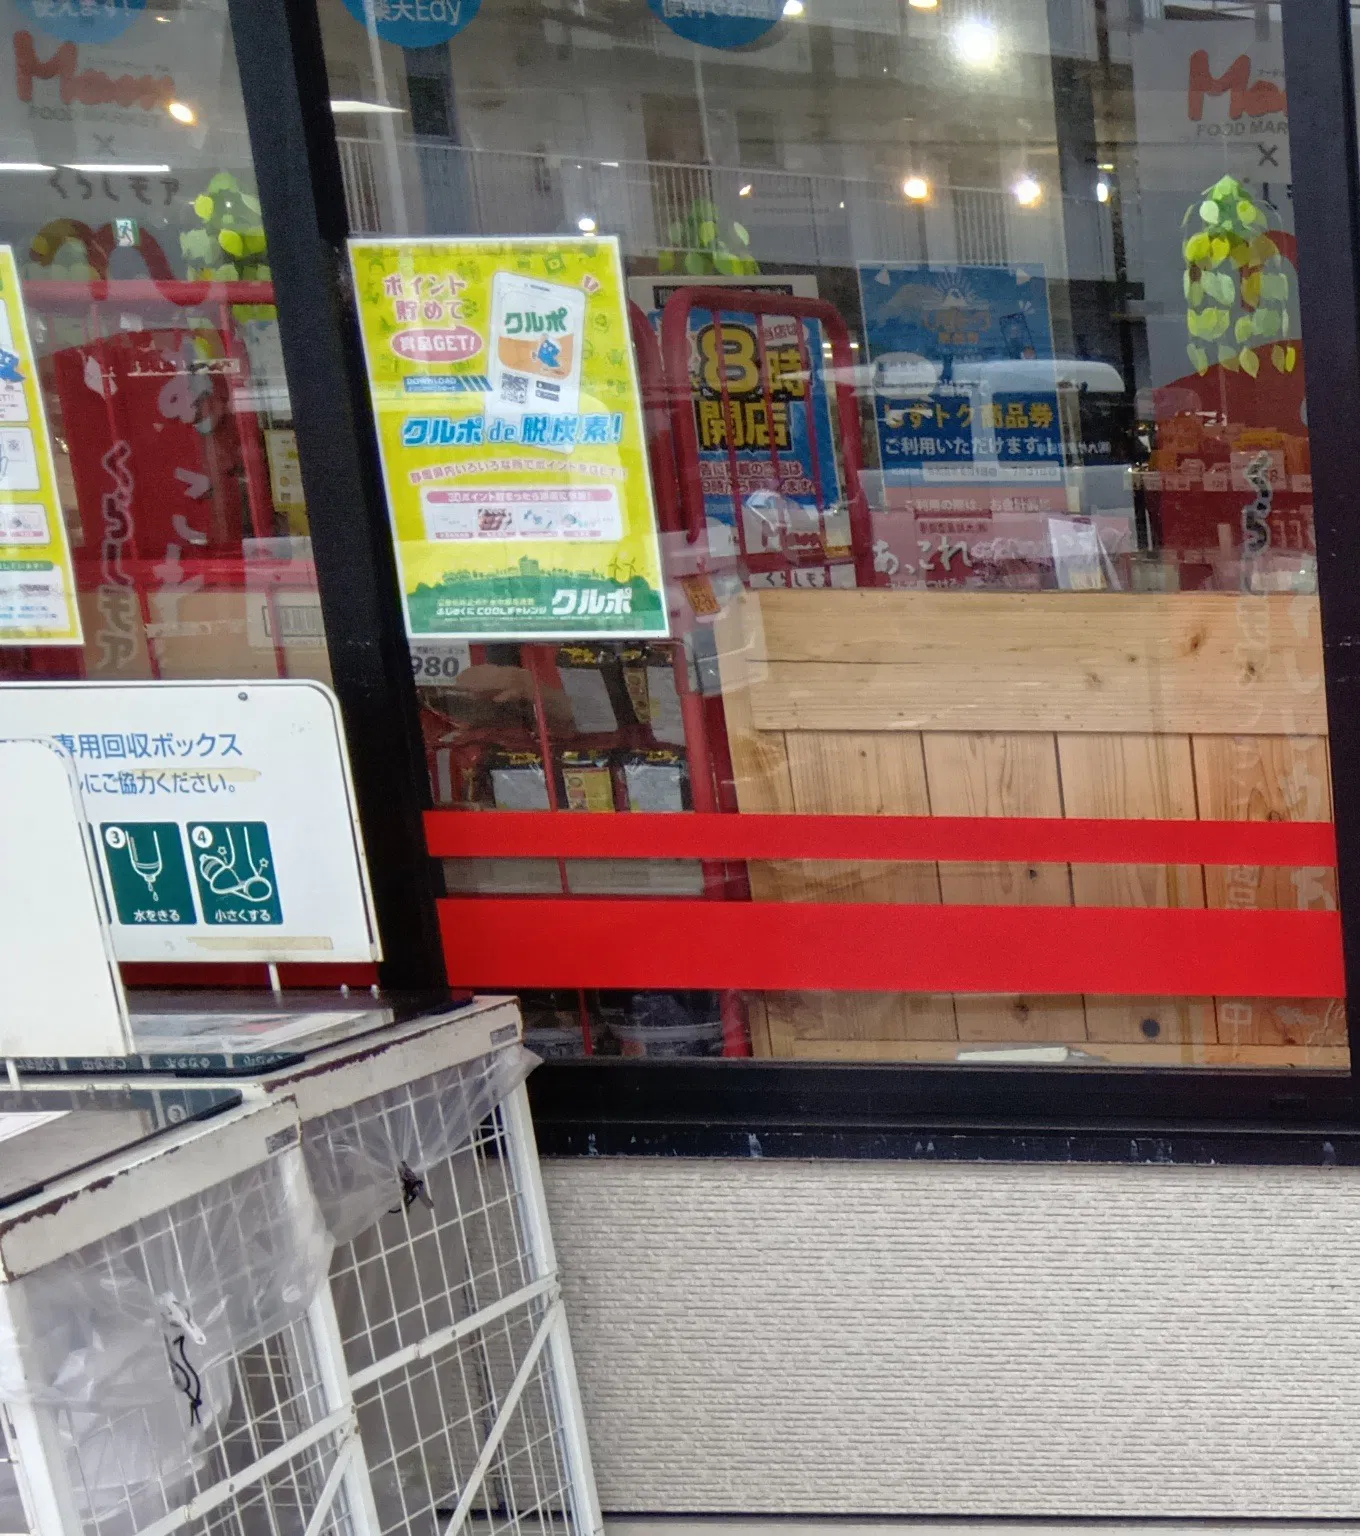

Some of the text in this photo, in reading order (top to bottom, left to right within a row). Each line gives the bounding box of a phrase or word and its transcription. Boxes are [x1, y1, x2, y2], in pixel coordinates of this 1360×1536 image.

[384, 274, 467, 297] ポイント
[395, 300, 464, 321] 貯めて
[504, 307, 569, 334] クルポ
[551, 587, 633, 616] クルポ
[54, 733, 243, 759] 専用回収ボックス
[80, 771, 237, 795] にご協力ください。
[133, 908, 180, 923] 水をきる
[214, 908, 272, 923] 小さくする
